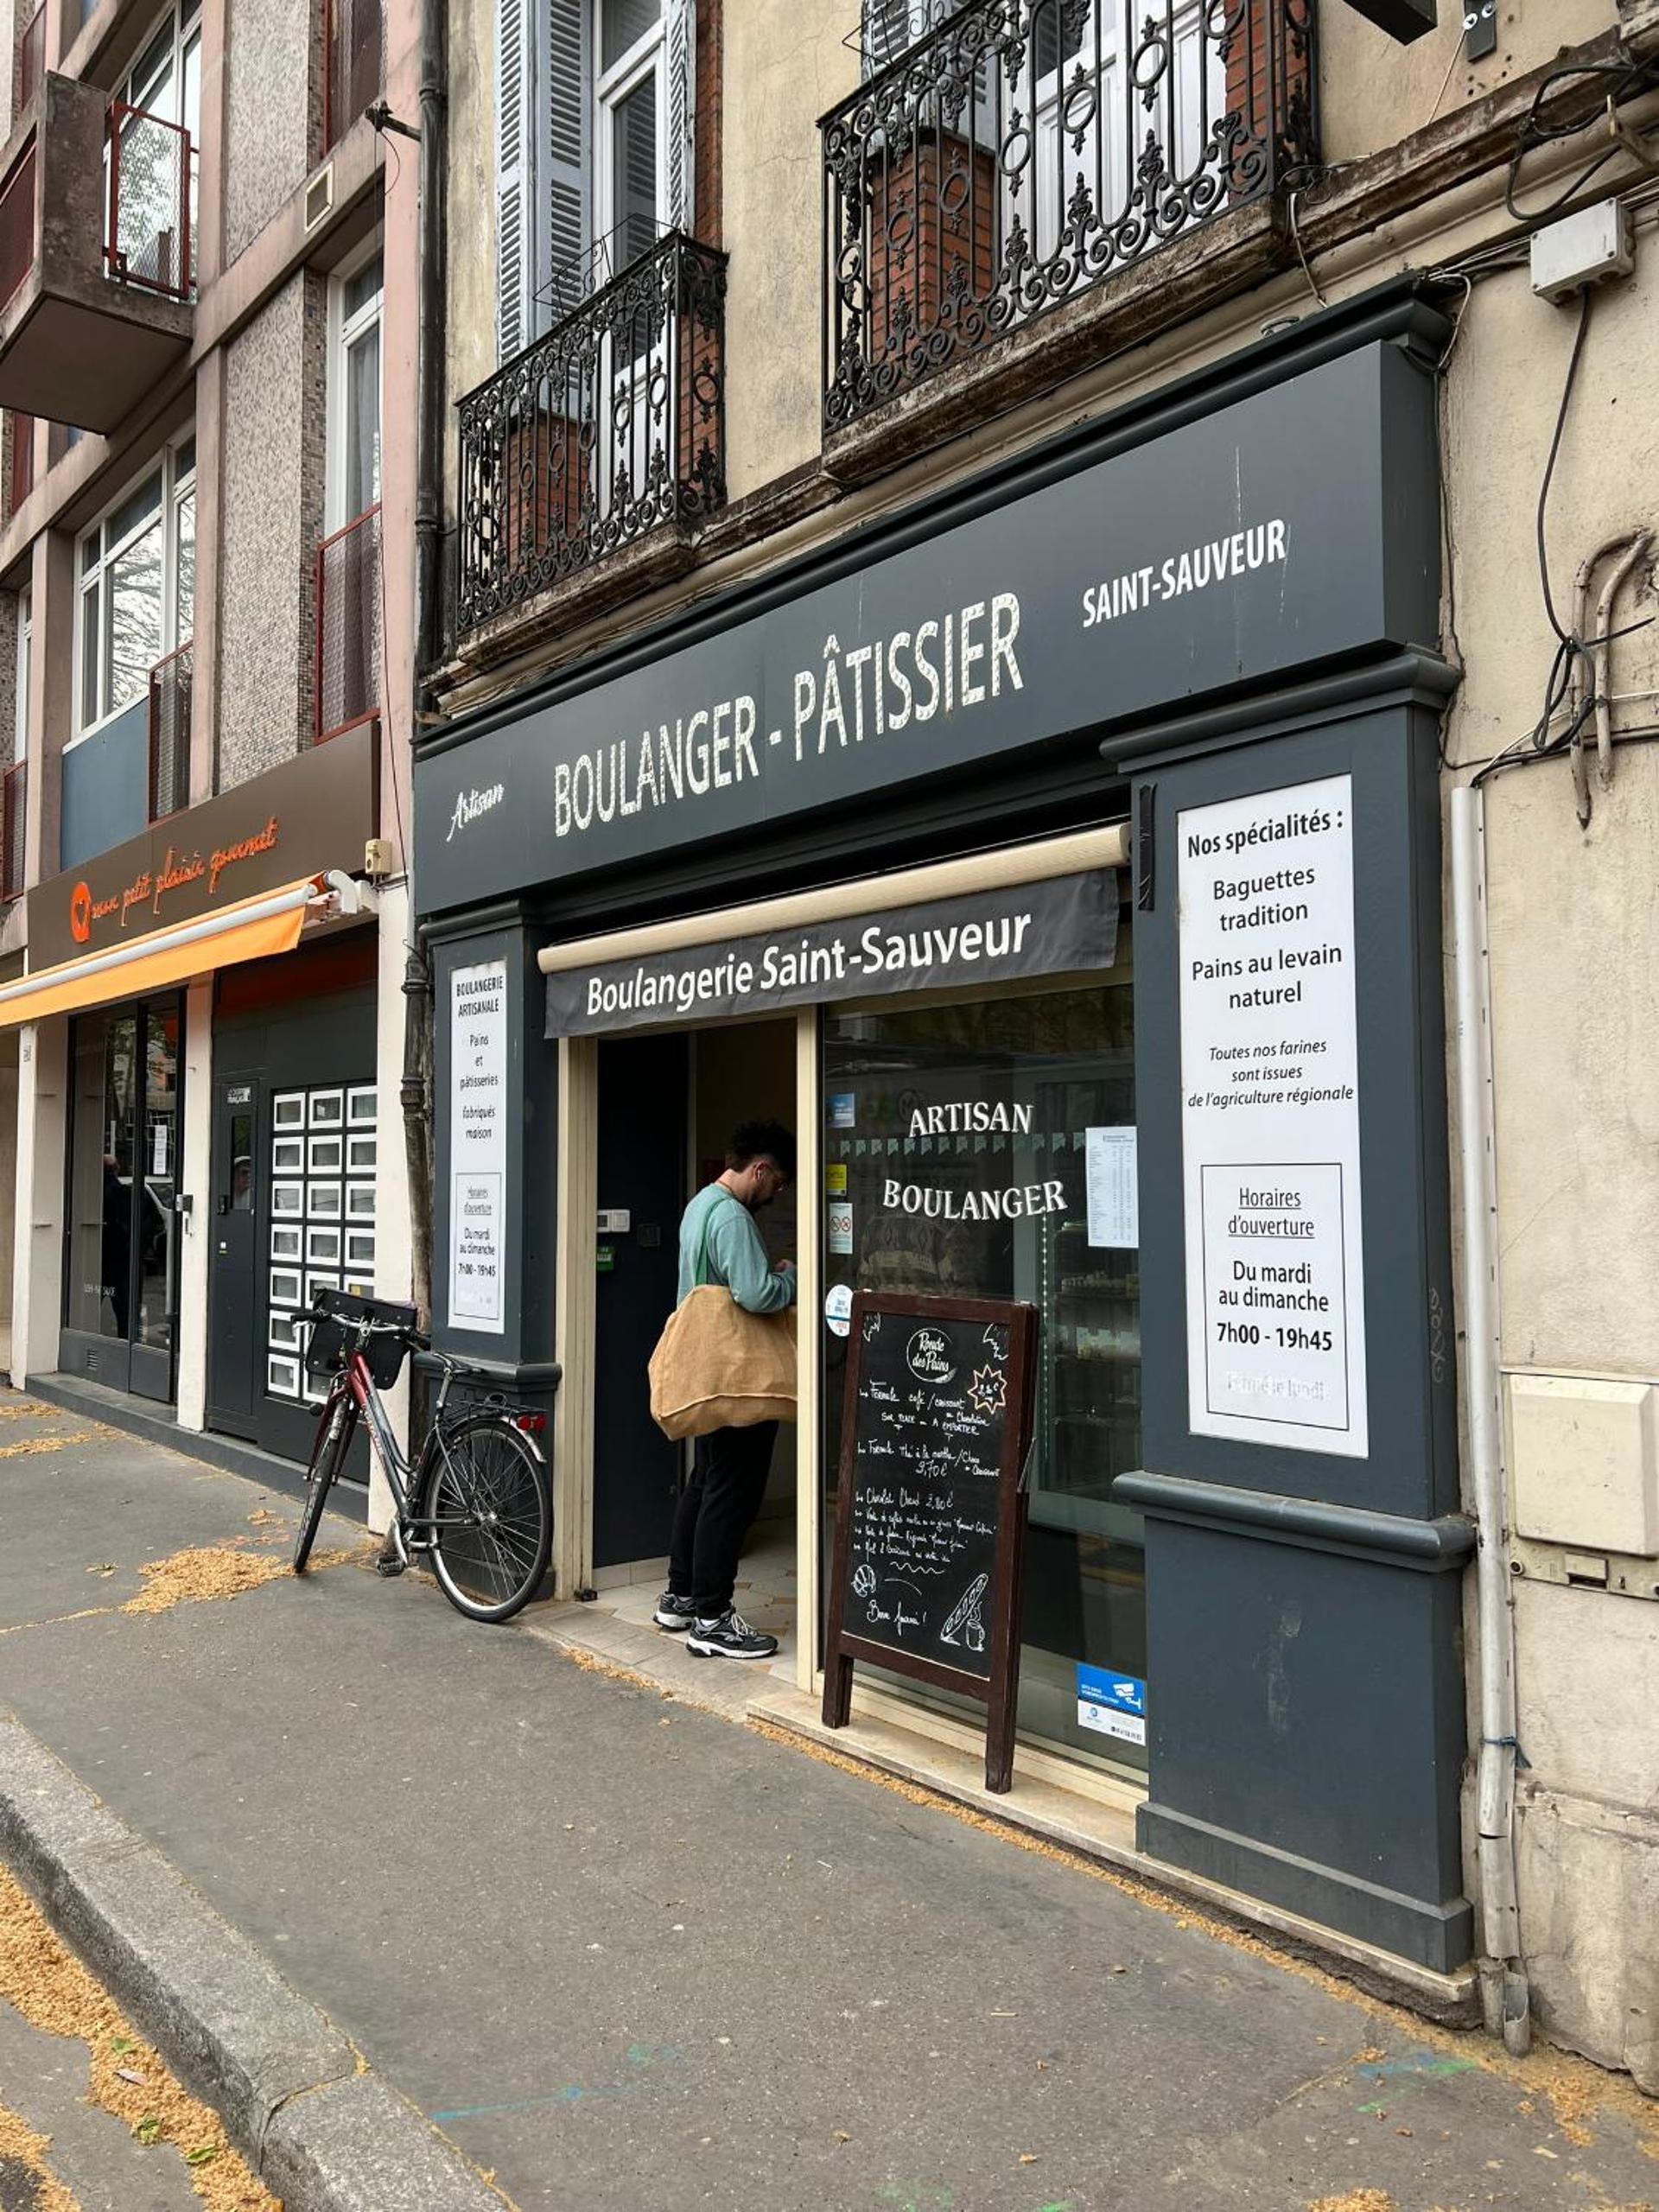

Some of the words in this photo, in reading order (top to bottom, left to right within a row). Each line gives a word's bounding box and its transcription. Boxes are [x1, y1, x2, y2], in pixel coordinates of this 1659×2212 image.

[447, 782, 505, 841] Artisan
[554, 693, 760, 837] BOULANGER
[769, 728, 782, 747] -
[793, 591, 1023, 762] PÂTISSIER
[1082, 518, 1287, 627] SAINT-SAUVEUR
[1188, 836, 1220, 857] Nos
[1226, 809, 1331, 854] spécialités
[1214, 867, 1314, 900] Baguettes
[1220, 901, 1307, 931] tradition
[586, 953, 753, 1014] Boulangerie
[760, 913, 1032, 989] Saint-Sauveur
[1192, 960, 1242, 980] Pains
[1249, 954, 1272, 973] au
[1279, 944, 1342, 970] levain
[456, 976, 504, 996] BOULANGERIE
[1230, 982, 1301, 1008] naturel
[458, 998, 499, 1018] ARTISANALE
[469, 1034, 489, 1046] Pains
[1210, 1044, 1250, 1061] Toutes
[1253, 1044, 1276, 1058] nos
[1280, 1039, 1327, 1057] farines
[475, 1055, 483, 1066] et
[460, 1075, 499, 1091] pâtisseries
[1231, 1069, 1260, 1083] sont
[1262, 1065, 1302, 1081] issues
[1188, 1093, 1203, 1107] de
[1287, 1085, 1354, 1103] régionale
[909, 1102, 1034, 1137] ARTISAN
[466, 1127, 492, 1140] maison
[883, 1179, 1067, 1220] BOULANGER
[1239, 1187, 1301, 1207] Horaires
[1233, 1261, 1255, 1281] Du
[1262, 1263, 1312, 1284] mardi
[1219, 1290, 1238, 1305] au
[1243, 1287, 1329, 1312] dimanche
[918, 1332, 944, 1352] Ronde
[1217, 1323, 1260, 1344] 7h00
[1275, 1327, 1332, 1351] 19h45
[912, 1354, 925, 1368] des
[925, 1351, 950, 1372] Pains
